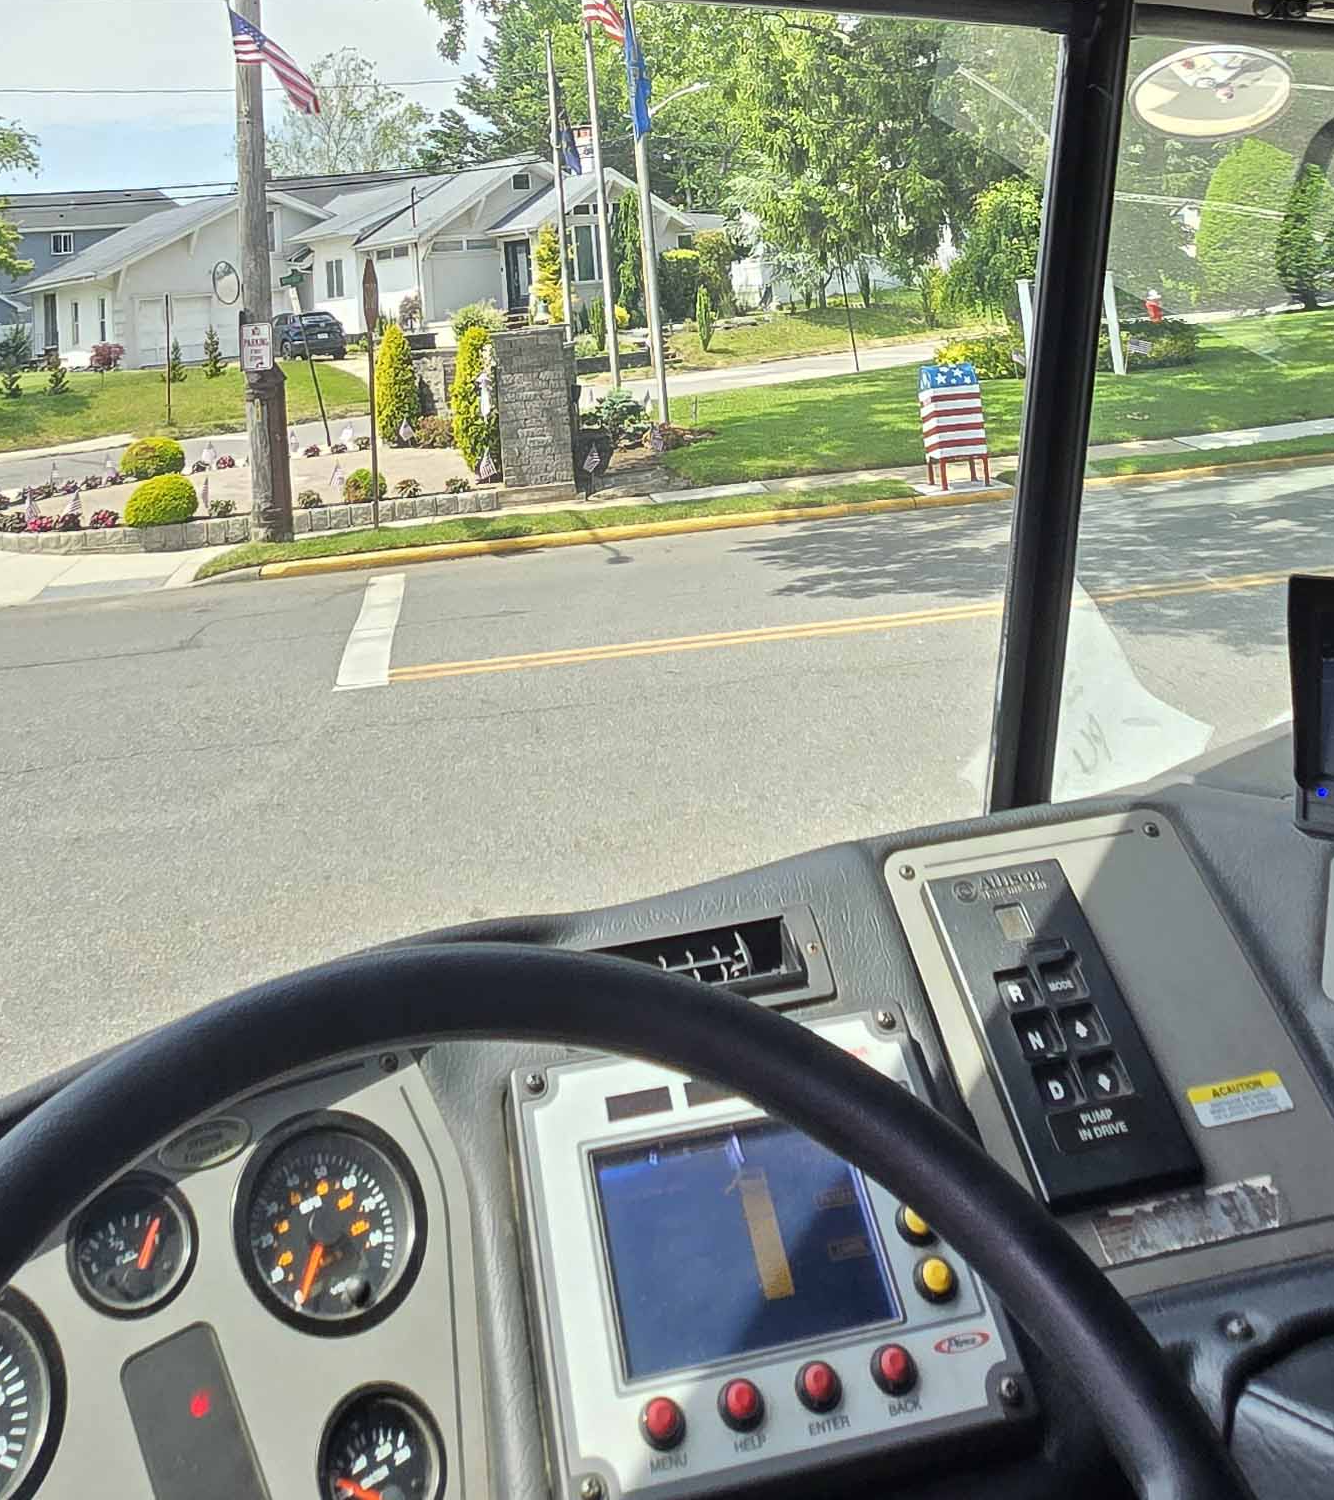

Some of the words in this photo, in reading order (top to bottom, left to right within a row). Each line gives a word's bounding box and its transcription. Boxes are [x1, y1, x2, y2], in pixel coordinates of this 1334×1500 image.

[1007, 983, 1025, 1003] R
[1047, 979, 1075, 993] MODE
[1027, 1030, 1046, 1051] N
[1047, 1079, 1065, 1101] D
[1219, 1079, 1264, 1096] CAUTION
[1079, 1107, 1114, 1127] PUMP
[1078, 1126, 1094, 1143] IN
[1092, 1119, 1130, 1140] DRIVE
[887, 1398, 923, 1418] BACK
[807, 1415, 852, 1437] ENTER
[732, 1434, 767, 1454] HELP
[649, 1453, 688, 1476] MENU
